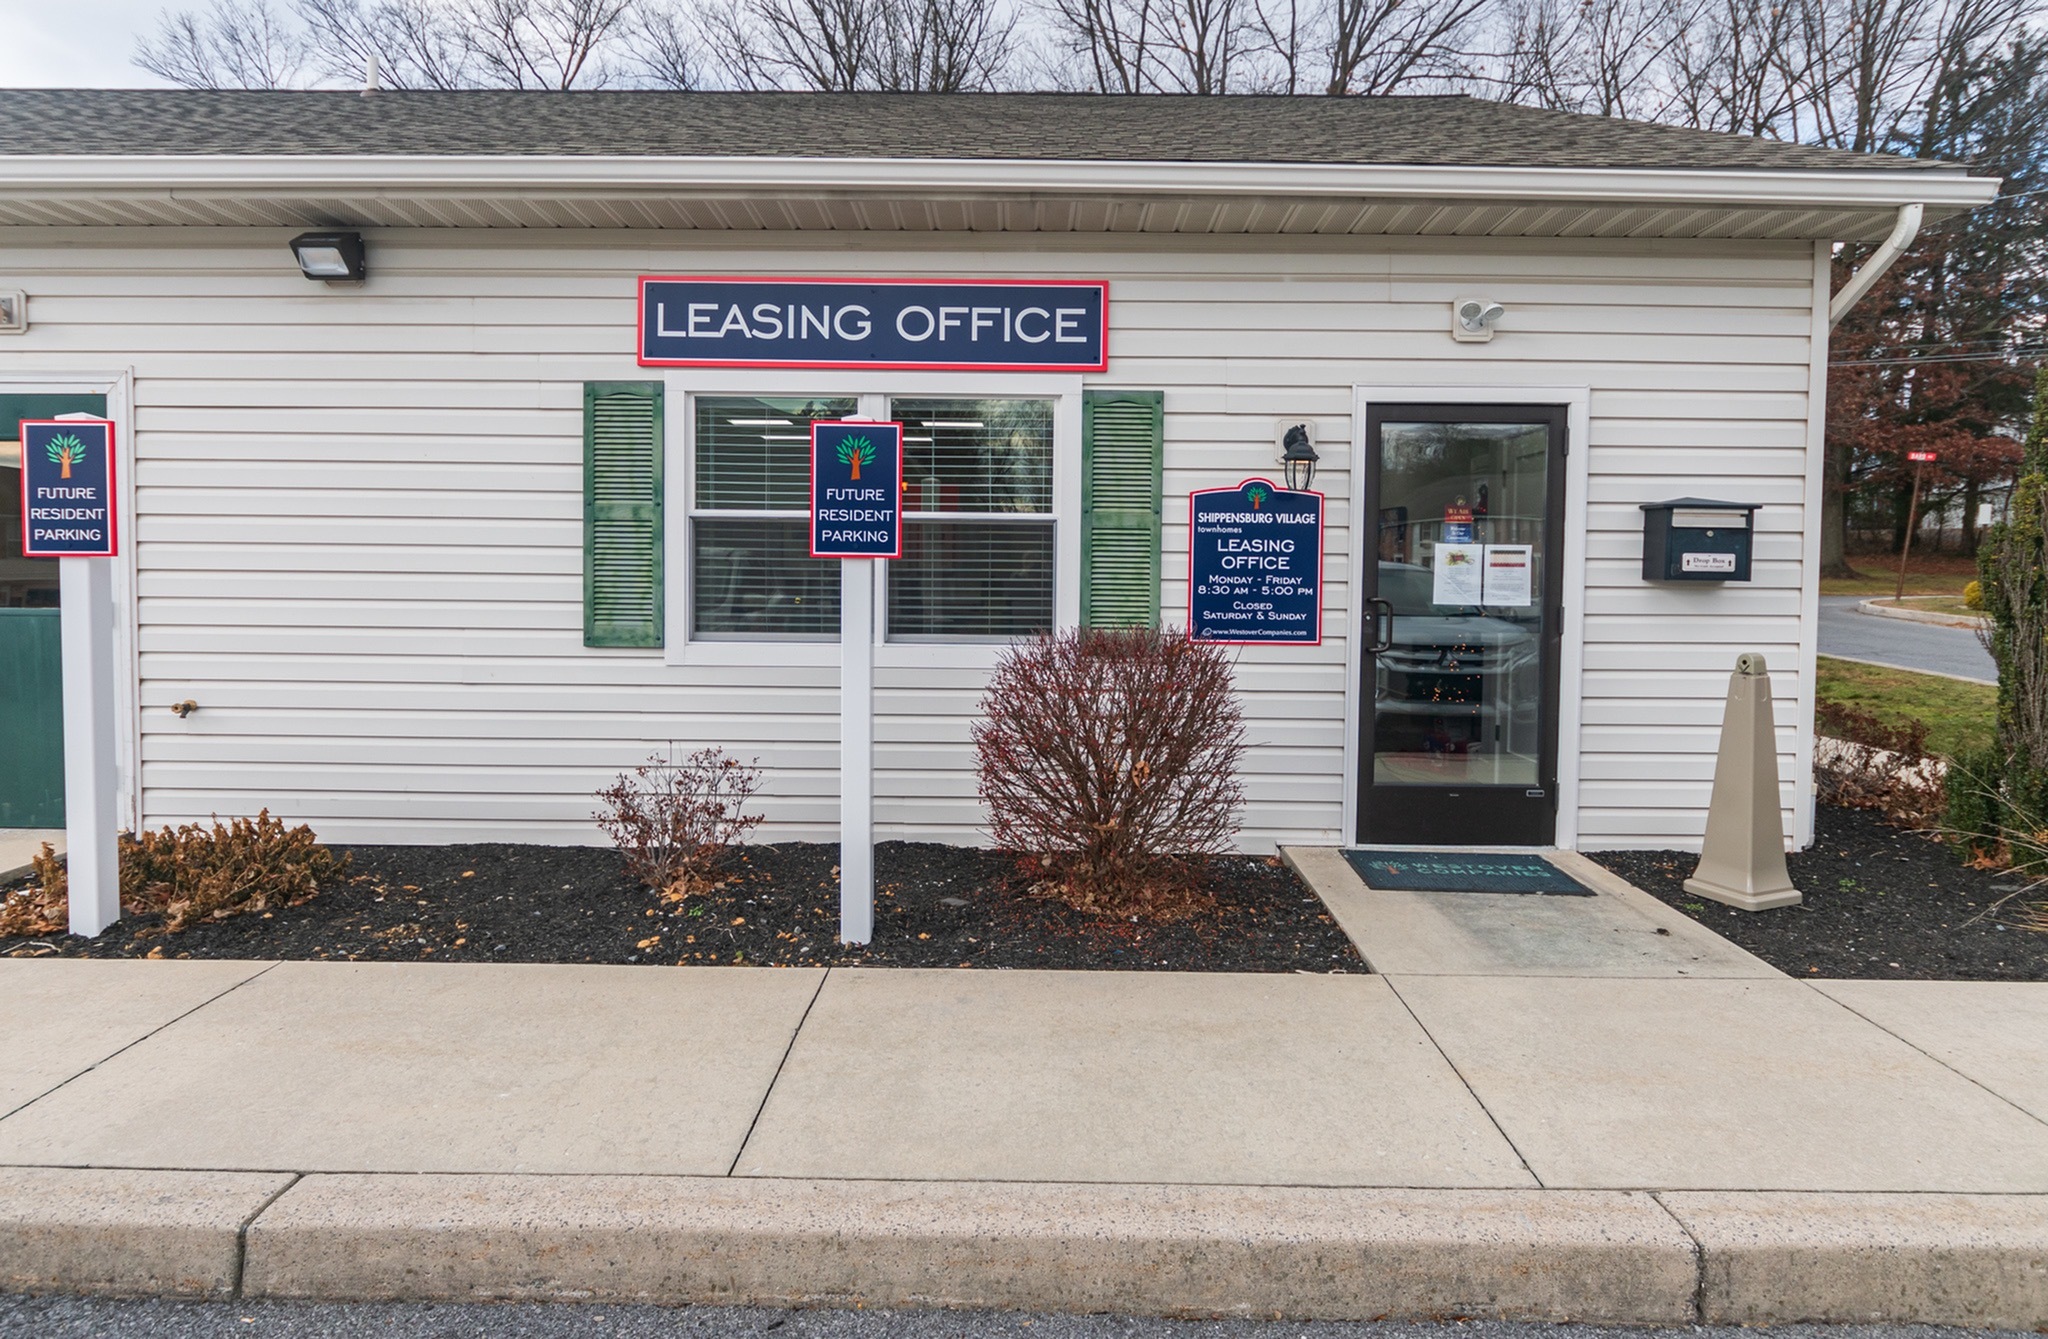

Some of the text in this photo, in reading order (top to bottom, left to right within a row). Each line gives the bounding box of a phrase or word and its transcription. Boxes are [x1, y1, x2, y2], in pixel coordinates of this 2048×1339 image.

[657, 302, 1088, 343] LEASING OFFICE
[37, 487, 97, 499] FUTURE
[826, 488, 885, 501] FUTURE
[30, 508, 105, 520] RESIDENT
[819, 509, 893, 522] RESIDENT
[1198, 512, 1316, 524] SHIPPENSBURG VILLAGE
[34, 529, 101, 541] PARKING
[1198, 525, 1242, 534] townhomes
[822, 530, 888, 542] PARKING
[1217, 539, 1295, 553] LEASING
[1221, 556, 1290, 570] OFFICE
[1693, 557, 1709, 565] Drop
[1208, 575, 1253, 584] MONDAY
[1265, 575, 1302, 585] FRIDAY
[1198, 586, 1230, 595] 8:30
[1233, 587, 1248, 595] AM
[1261, 586, 1293, 595] 5:00
[1298, 588, 1313, 596] PM
[1233, 601, 1273, 610] CLOSED
[1203, 611, 1307, 621] SATURDAY & SUNDAY
[1212, 628, 1307, 637] www.WestoverCompanies.com
[1411, 862, 1543, 871] WESTOVER
[1417, 868, 1551, 877] COMPANIES
